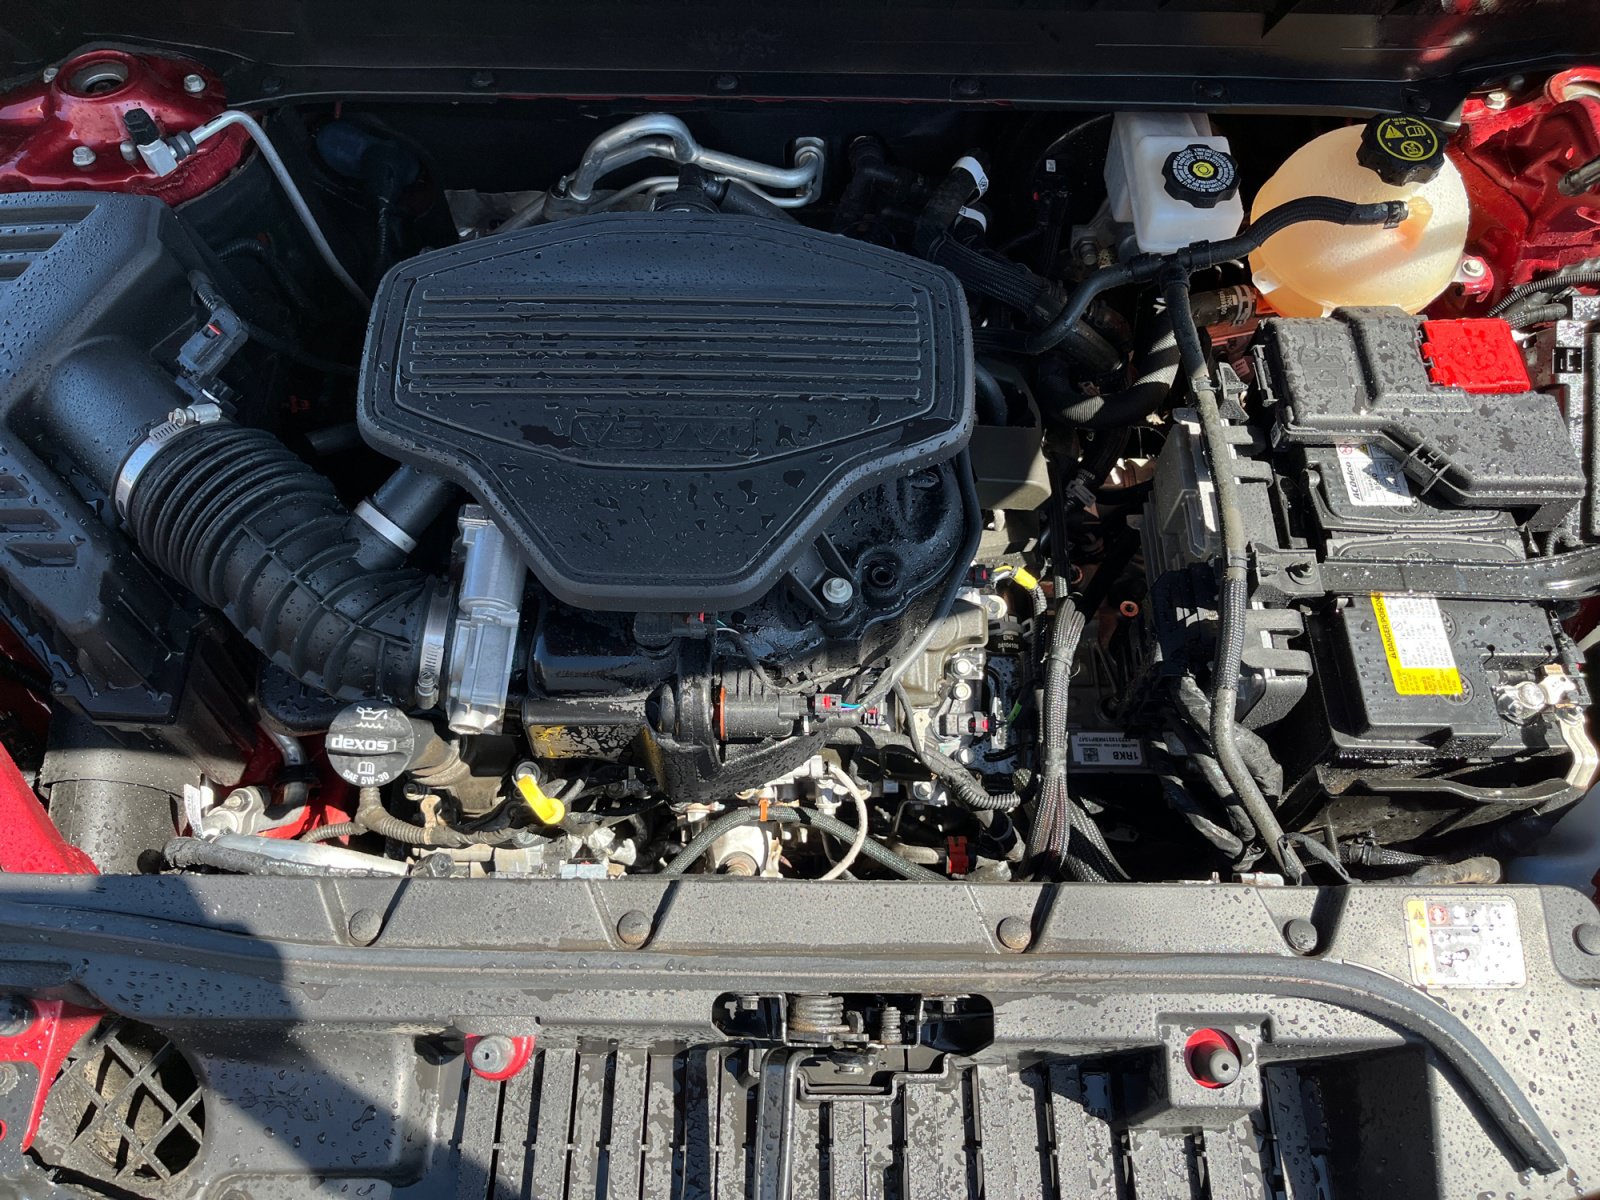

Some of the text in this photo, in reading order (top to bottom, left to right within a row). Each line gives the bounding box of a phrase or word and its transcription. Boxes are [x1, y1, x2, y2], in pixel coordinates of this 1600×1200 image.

[1345, 461, 1361, 501] ACDelco
[1112, 751, 1139, 760] 1RKB
[342, 769, 390, 785] SAE 5W-30
